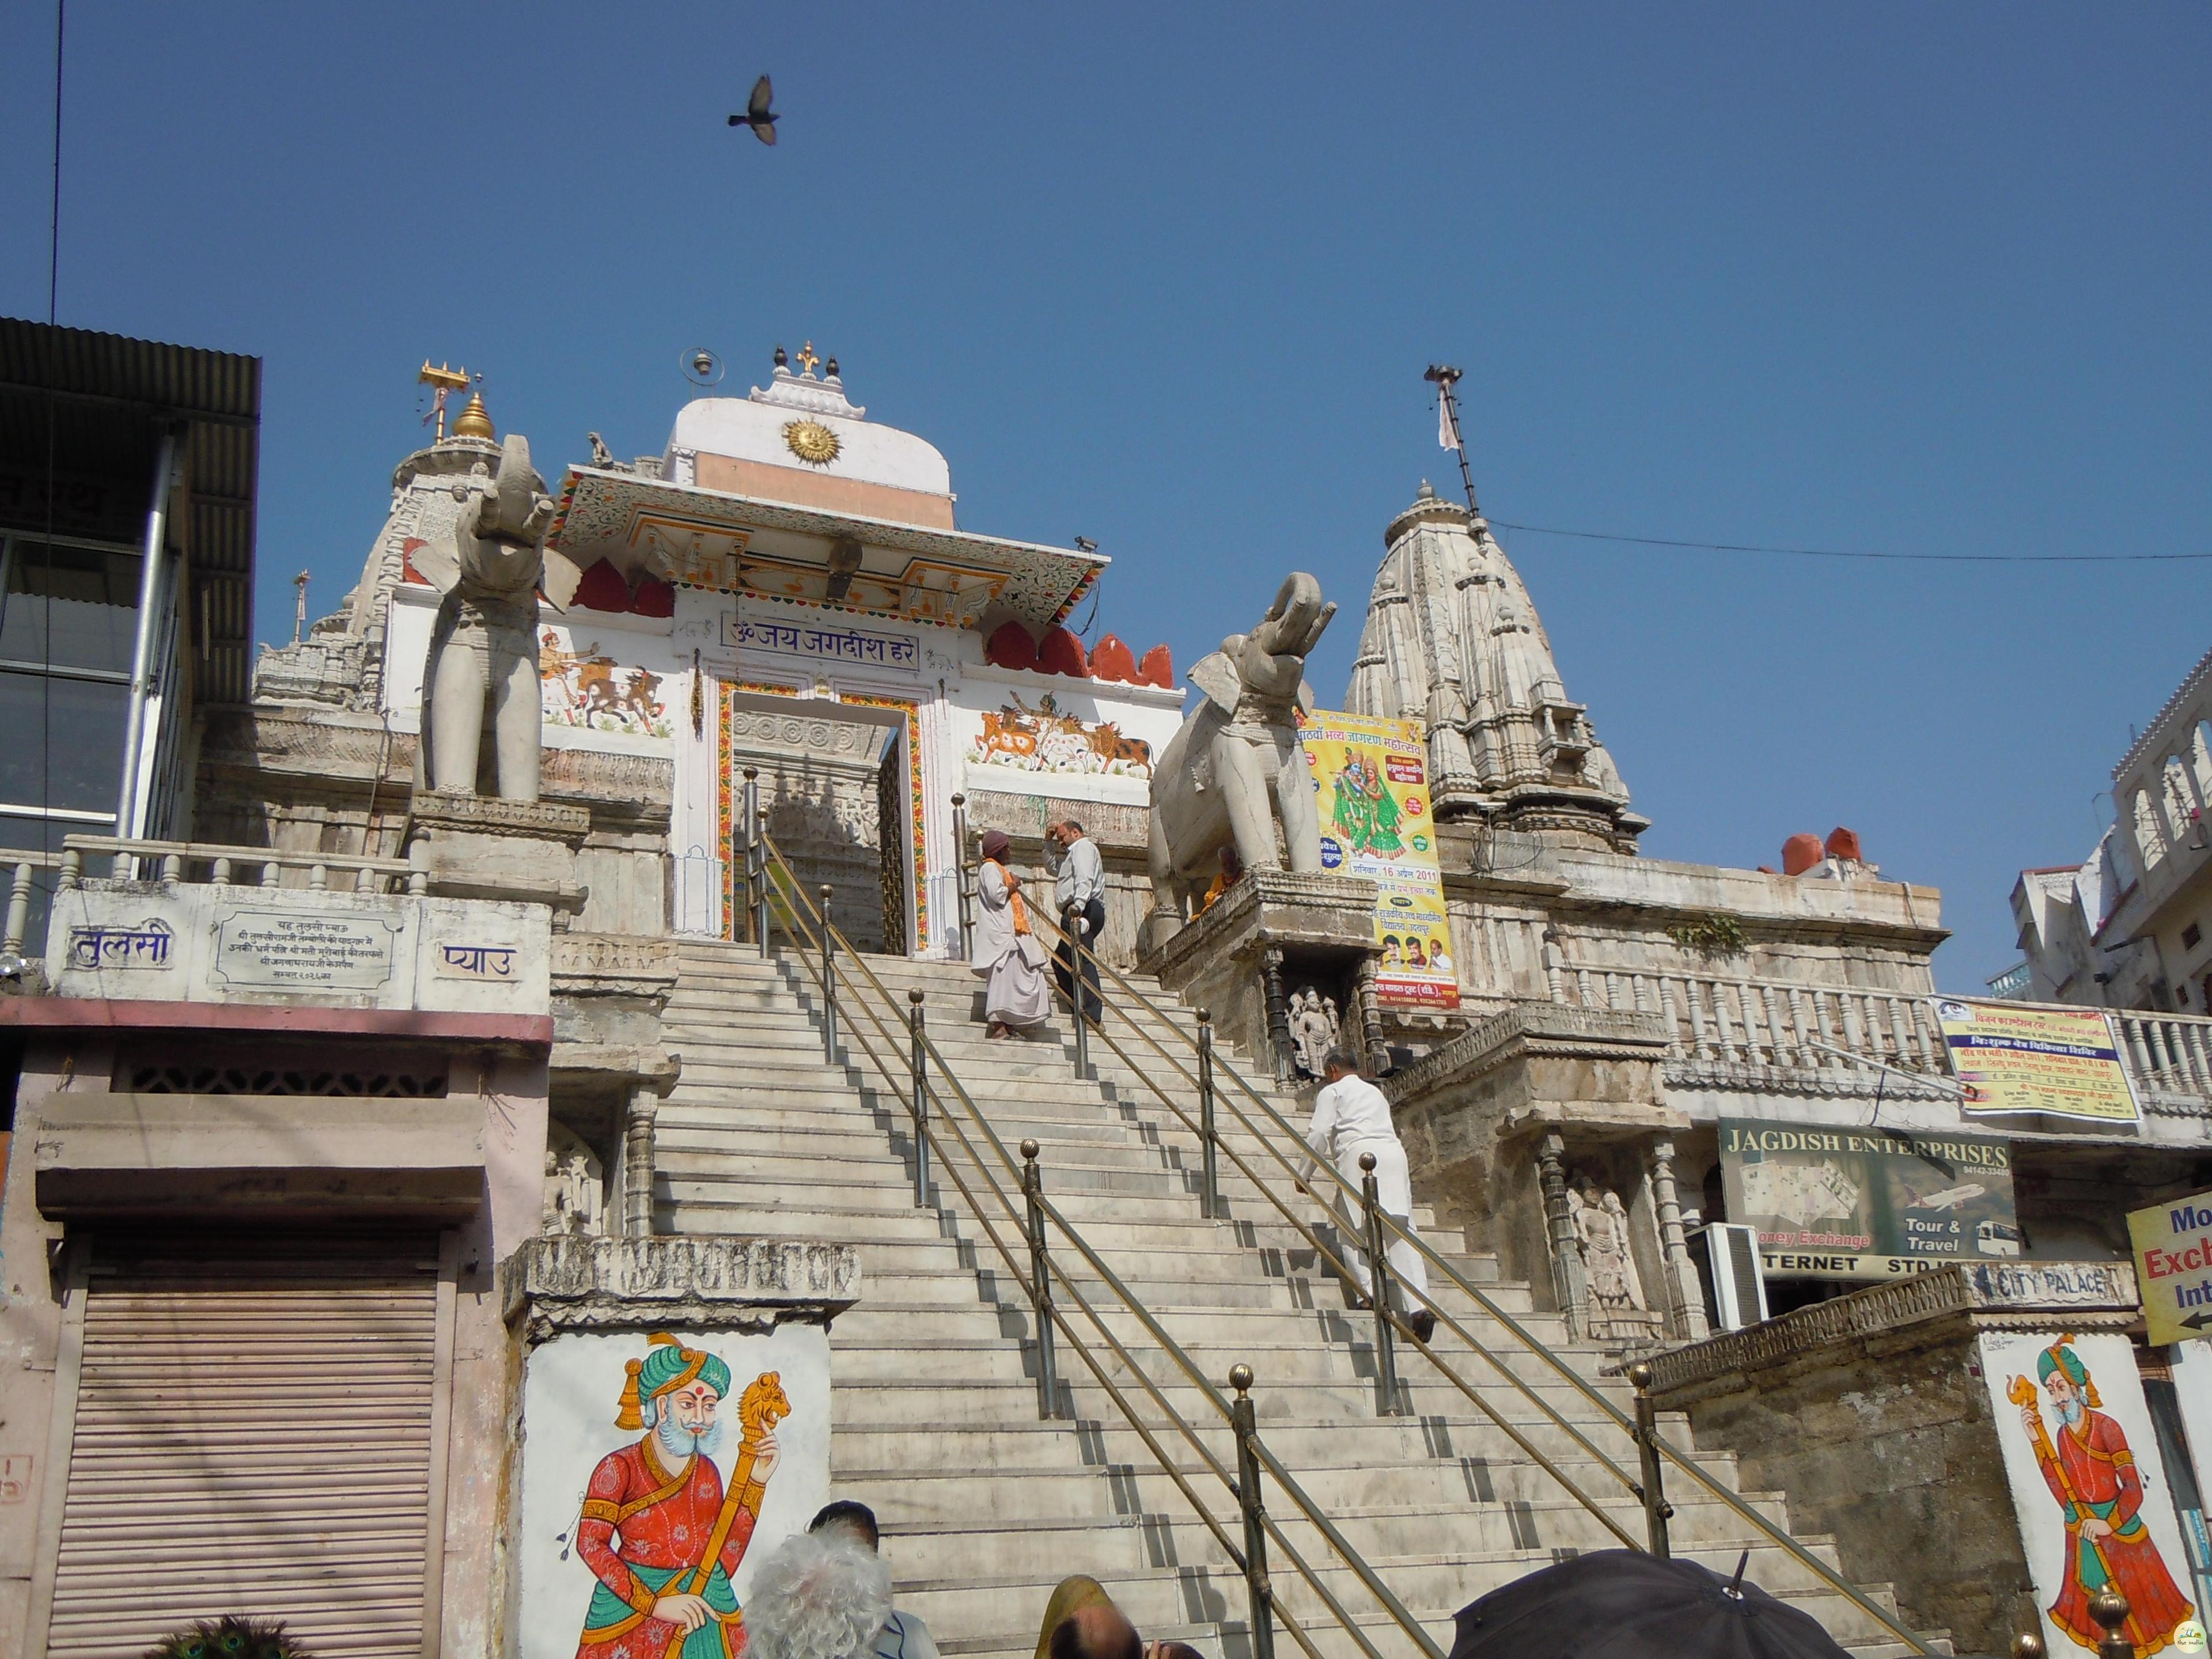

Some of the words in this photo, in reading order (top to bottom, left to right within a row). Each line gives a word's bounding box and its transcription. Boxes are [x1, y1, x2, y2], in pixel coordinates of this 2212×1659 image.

[754, 623, 800, 650] जय
[802, 630, 885, 661] जगदीश
[888, 638, 914, 666] हरे
[1325, 730, 1344, 741] भव्य
[1347, 732, 1382, 745] जागरण
[1384, 736, 1421, 756] महोत्सव
[1382, 866, 1393, 877] 16
[1416, 870, 1437, 881] 2011
[1380, 907, 1403, 919] राजकीय
[1416, 911, 1442, 922] माध्यमिक
[276, 921, 292, 931] यह
[296, 920, 323, 934] तुलसी
[1410, 924, 1430, 936] उदयपुर
[71, 923, 171, 968] तुलसी
[2013, 1039, 2028, 1049] नेत्र
[2030, 1040, 2067, 1053] चिकित्सा
[2069, 1045, 2097, 1056] शिविर
[1728, 1129, 1842, 1152] JAGDISH
[1847, 1136, 2009, 1168] ENTERPRISES
[1963, 1165, 2010, 1177] 94142-33480
[1905, 1218, 1944, 1233] Tour
[1948, 1218, 1961, 1234] &
[1757, 1232, 1796, 1247] oney
[1798, 1229, 1870, 1250] Exchange
[1907, 1236, 1959, 1252] Travel
[1762, 1255, 1859, 1271] TERNET
[1887, 1259, 1929, 1274] STD
[1997, 1269, 2039, 1296] CITY
[2045, 1269, 2104, 1294] PALACE
